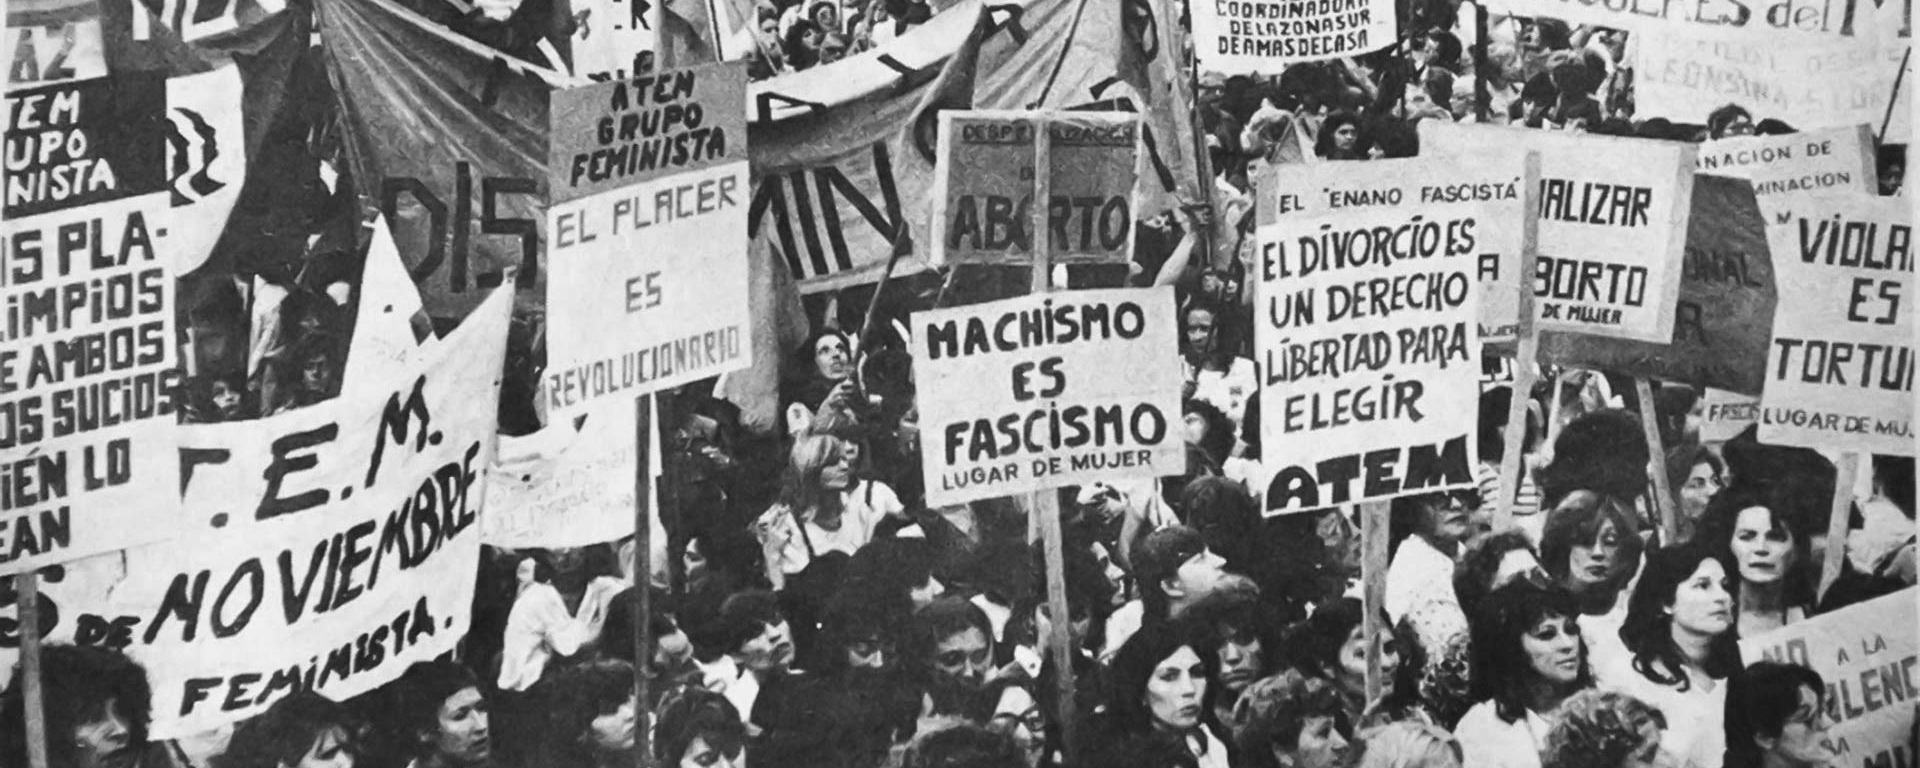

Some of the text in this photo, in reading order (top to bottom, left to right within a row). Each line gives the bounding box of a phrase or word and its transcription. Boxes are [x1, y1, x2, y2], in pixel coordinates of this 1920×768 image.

[611, 69, 696, 112] ATEM
[597, 102, 703, 146] GRUPO
[1806, 140, 1832, 157] DE
[5, 128, 87, 171] UPO
[571, 126, 726, 188] FEMINISTA
[8, 157, 116, 206] NISTA
[1280, 194, 1305, 215] EL
[1538, 178, 1652, 228] ALIZAR
[556, 174, 738, 249] EL PLACER
[0, 210, 168, 286] S PLA-
[1263, 241, 1293, 283] EL
[1444, 217, 1476, 258] ES
[1798, 212, 1915, 274] VIOLA
[0, 267, 164, 344] IMPIOS
[625, 270, 663, 315] ES
[1269, 270, 1469, 329] UN DERECHO
[1848, 277, 1902, 326] ES
[26, 319, 165, 390] AMBOS
[549, 324, 741, 410] REVOLUCIONARIO
[1396, 321, 1470, 370] PARA
[1774, 336, 1915, 392] TORTU
[1012, 356, 1066, 402] ES
[1762, 406, 1839, 434] LUGAR
[1844, 416, 1871, 433] DE
[84, 437, 132, 492] LO
[942, 449, 1152, 491] LUGAR DE MUJER
[1265, 434, 1475, 512] ATEM
[73, 613, 141, 650] DE
[143, 440, 481, 644] NOVIEMBRE
[1837, 647, 1850, 667] A
[1861, 634, 1888, 655] LA
